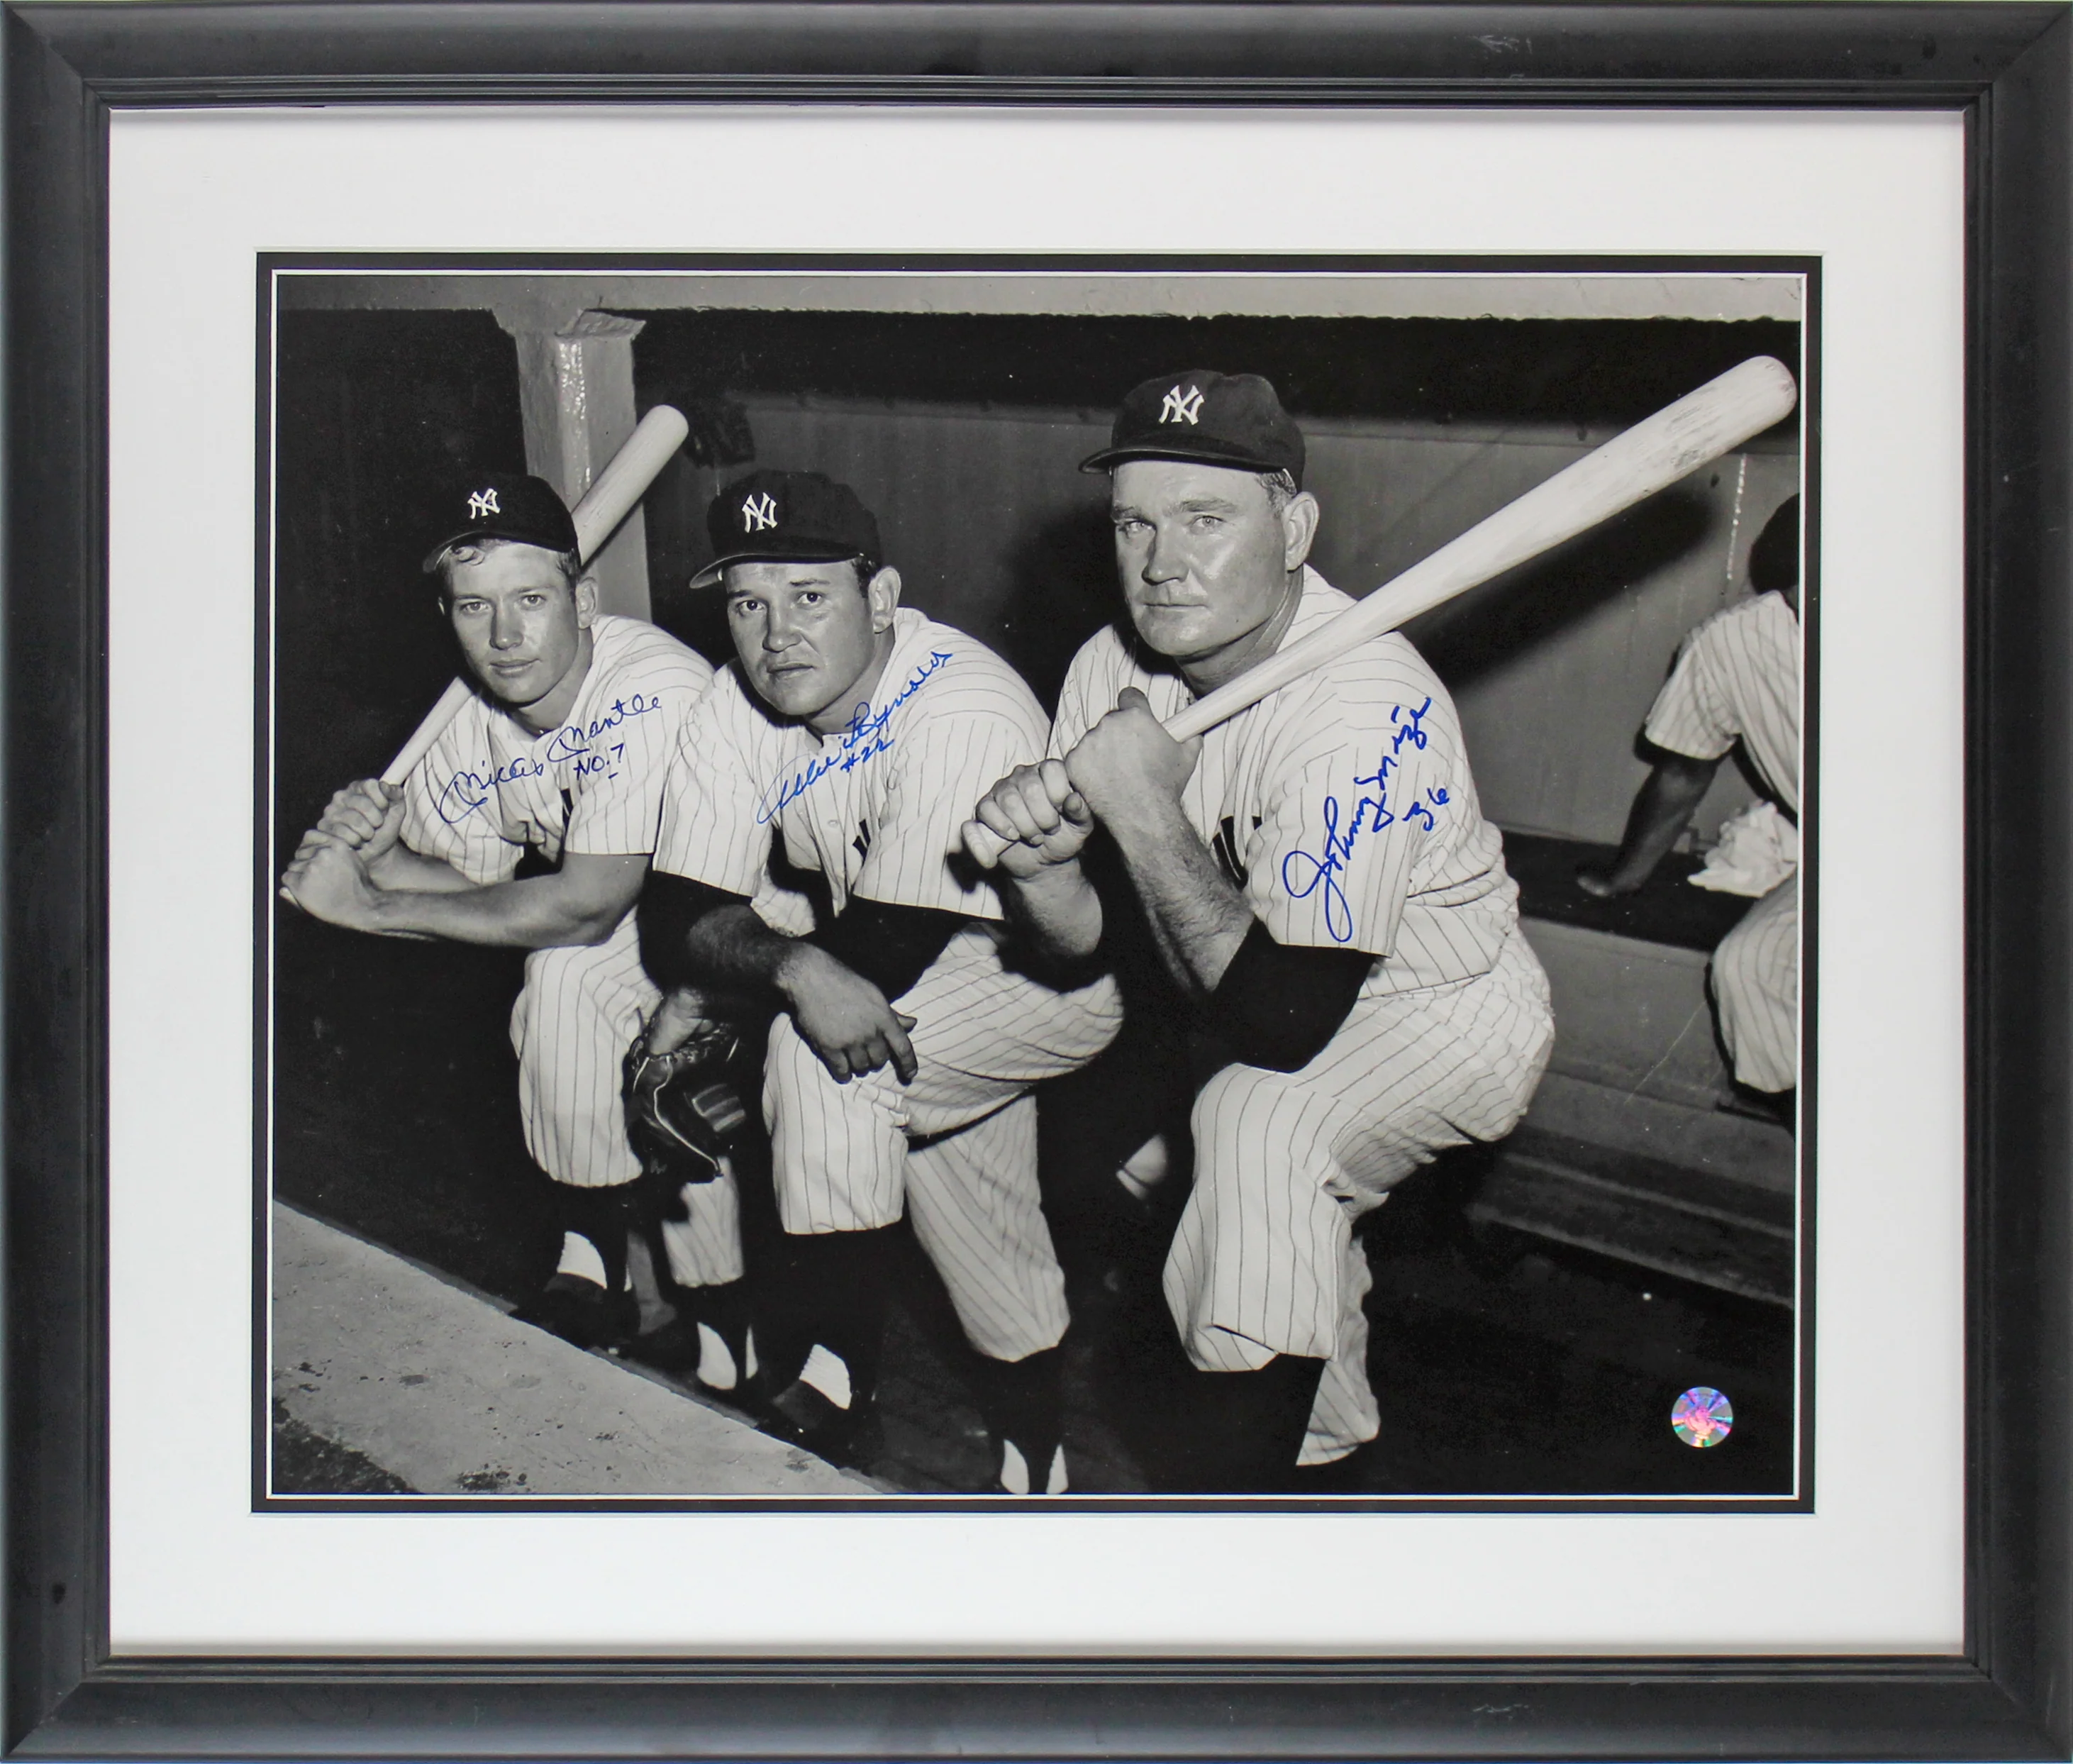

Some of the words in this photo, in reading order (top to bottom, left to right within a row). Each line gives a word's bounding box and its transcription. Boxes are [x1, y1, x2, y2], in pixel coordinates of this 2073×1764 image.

[1158, 384, 1205, 426] NY
[467, 488, 501, 519] NY
[741, 492, 778, 533] NY
[547, 693, 662, 762] Mantle
